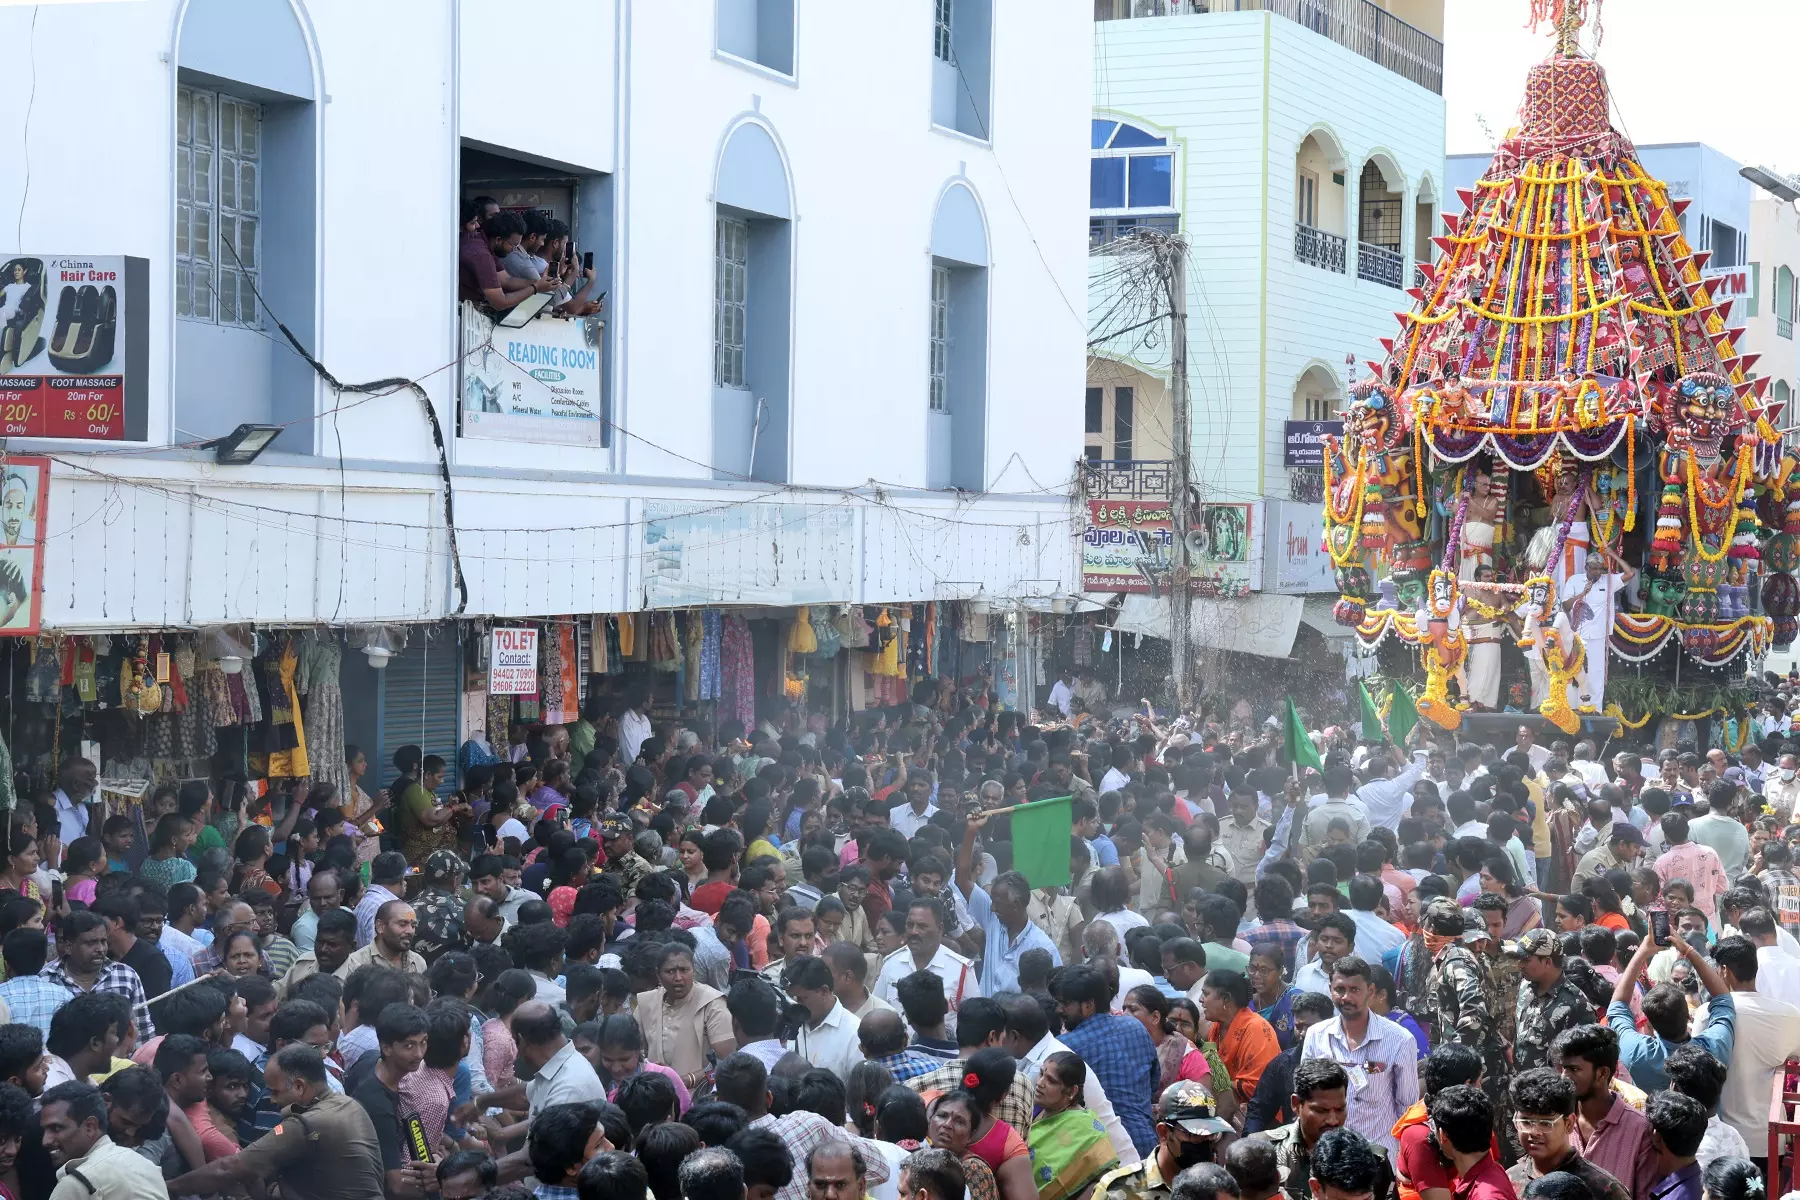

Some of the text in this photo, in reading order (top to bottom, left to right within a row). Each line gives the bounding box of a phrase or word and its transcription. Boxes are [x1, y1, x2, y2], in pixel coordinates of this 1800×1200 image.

[1667, 180, 1689, 195] EX
[60, 260, 94, 269] Chinna
[61, 270, 117, 282] Hair Care
[1706, 272, 1747, 295] YM
[508, 341, 596, 370] READING ROOM
[534, 370, 561, 381] FACILITIES
[0, 379, 36, 387] ASSAGE
[51, 379, 117, 387] FOOT MASSAGE
[6, 392, 22, 401] For
[67, 392, 104, 401] 20m For
[63, 409, 76, 421] Rs
[86, 403, 120, 423] 60/-
[512, 405, 529, 414] Mineral
[6, 423, 27, 435] Only
[88, 424, 110, 436] Only
[495, 630, 536, 650] TOLET
[499, 651, 531, 664] Contact:
[493, 668, 536, 680] 94402 70901
[492, 680, 535, 692] 91606 22228
[411, 1119, 430, 1163] GARRETT
